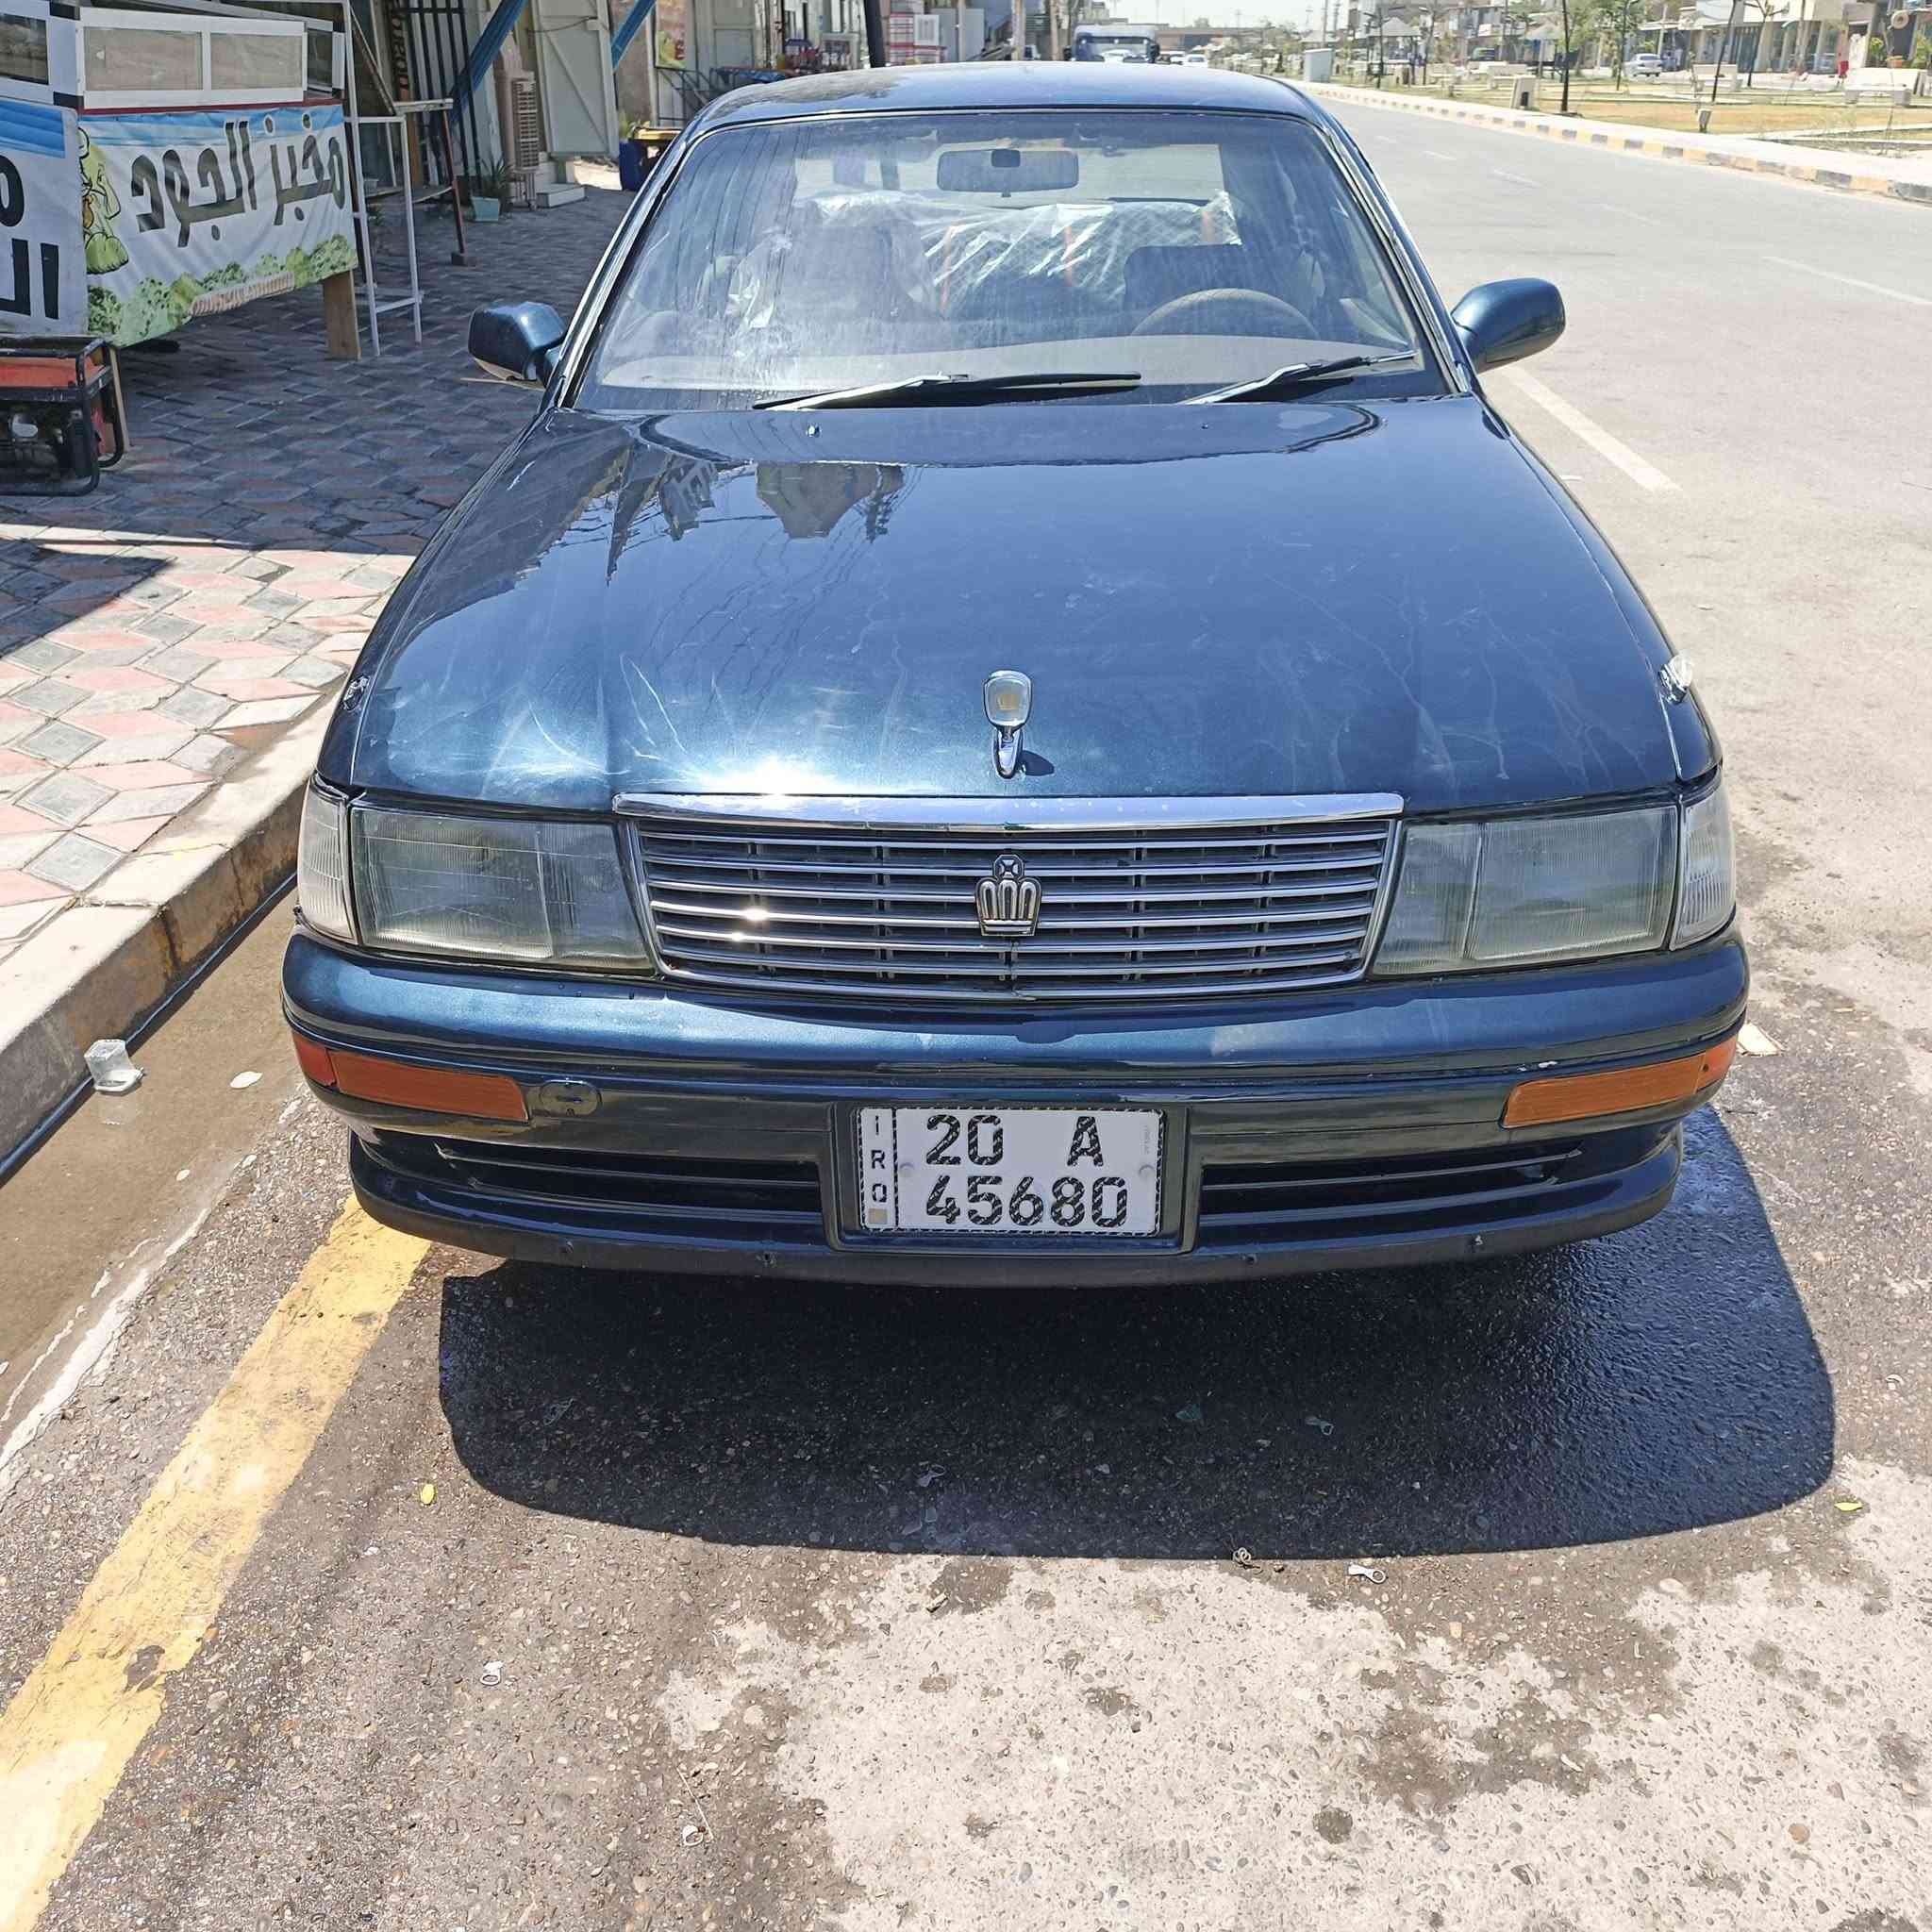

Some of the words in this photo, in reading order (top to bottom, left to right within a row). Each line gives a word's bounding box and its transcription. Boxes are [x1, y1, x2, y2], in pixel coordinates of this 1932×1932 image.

[131, 121, 257, 247] الجود
[265, 113, 345, 225] مخبز
[926, 1114, 1003, 1166] 20
[1067, 1116, 1104, 1167] A
[925, 1175, 1127, 1227] 45680
